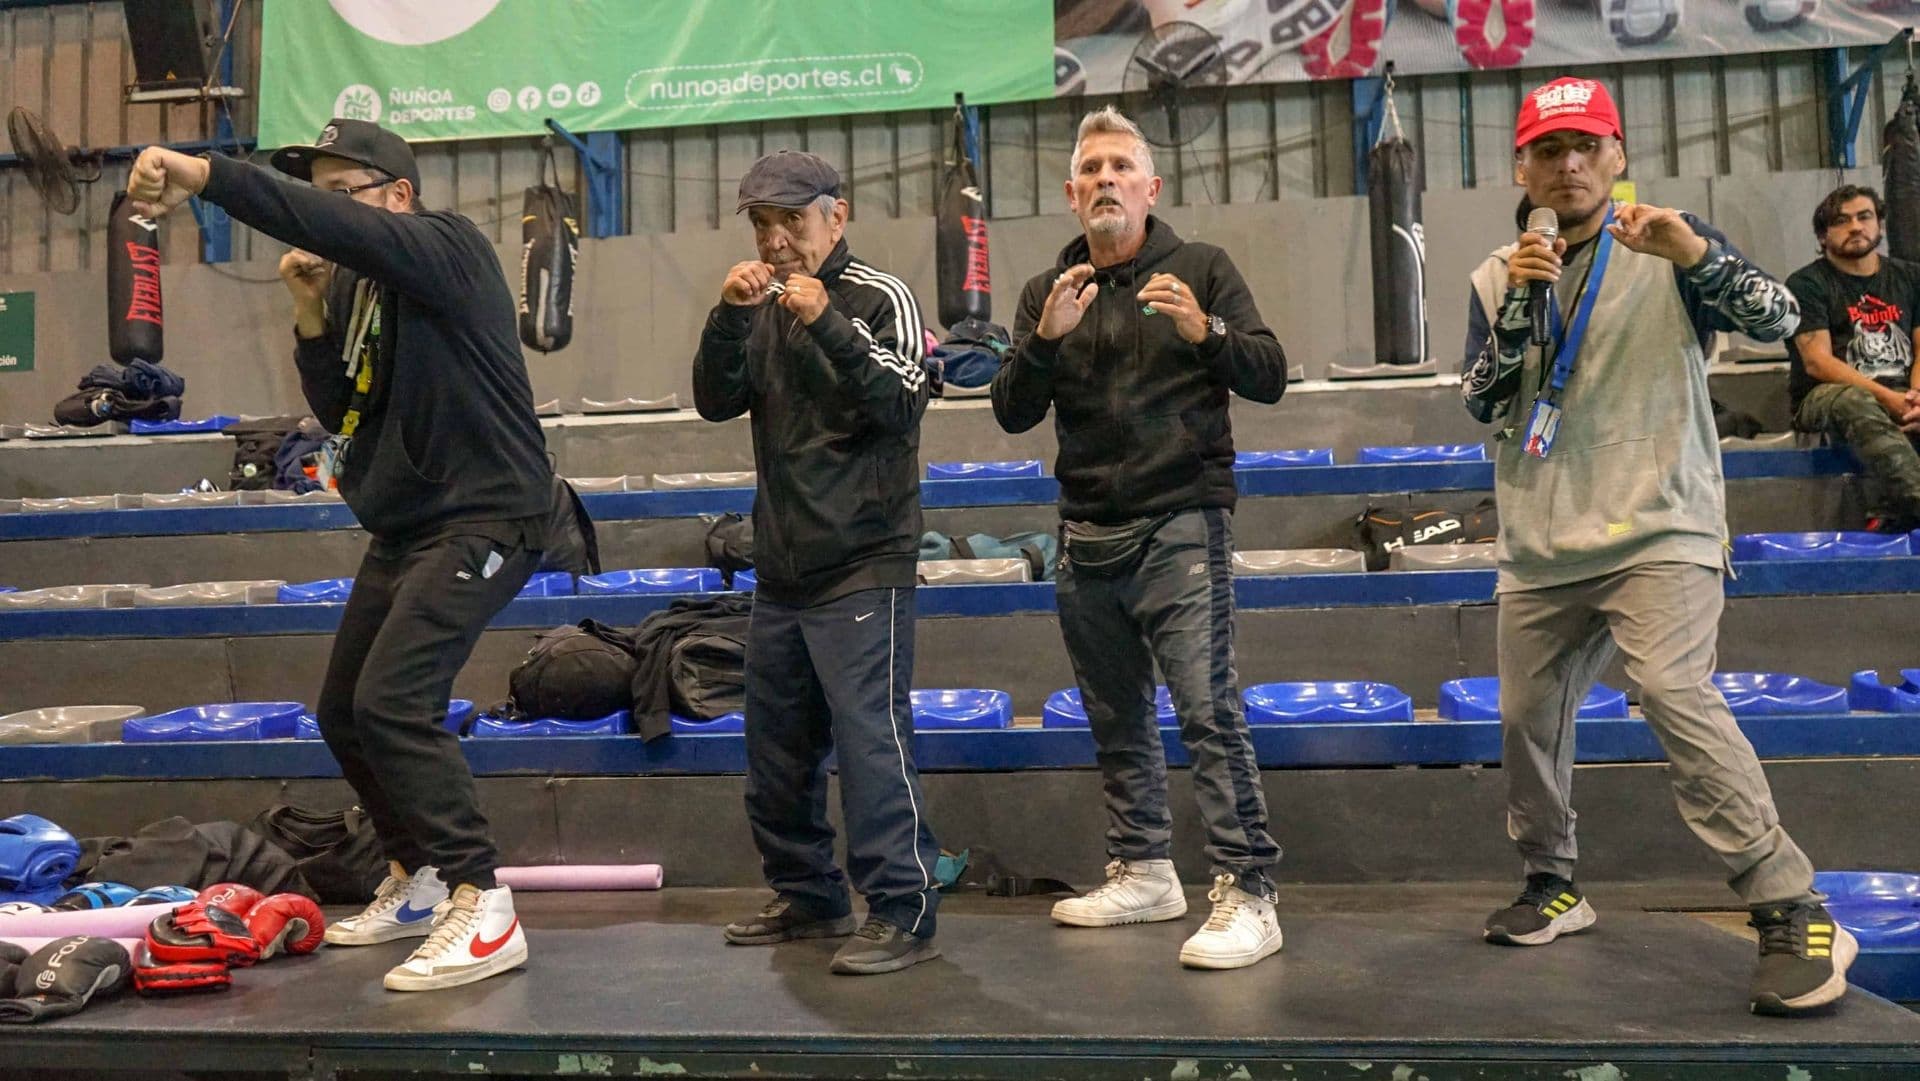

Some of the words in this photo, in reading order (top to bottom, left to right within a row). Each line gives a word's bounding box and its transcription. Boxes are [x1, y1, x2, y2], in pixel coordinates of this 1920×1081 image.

[389, 86, 453, 104] ÑUÑOA
[650, 63, 882, 99] nunoadeportes.cl
[389, 105, 476, 124] DEPORTES
[960, 215, 992, 292] EVERLAST
[125, 240, 163, 327] EVERLAST
[1383, 519, 1461, 553] HEAD
[47, 935, 89, 968] FOU
